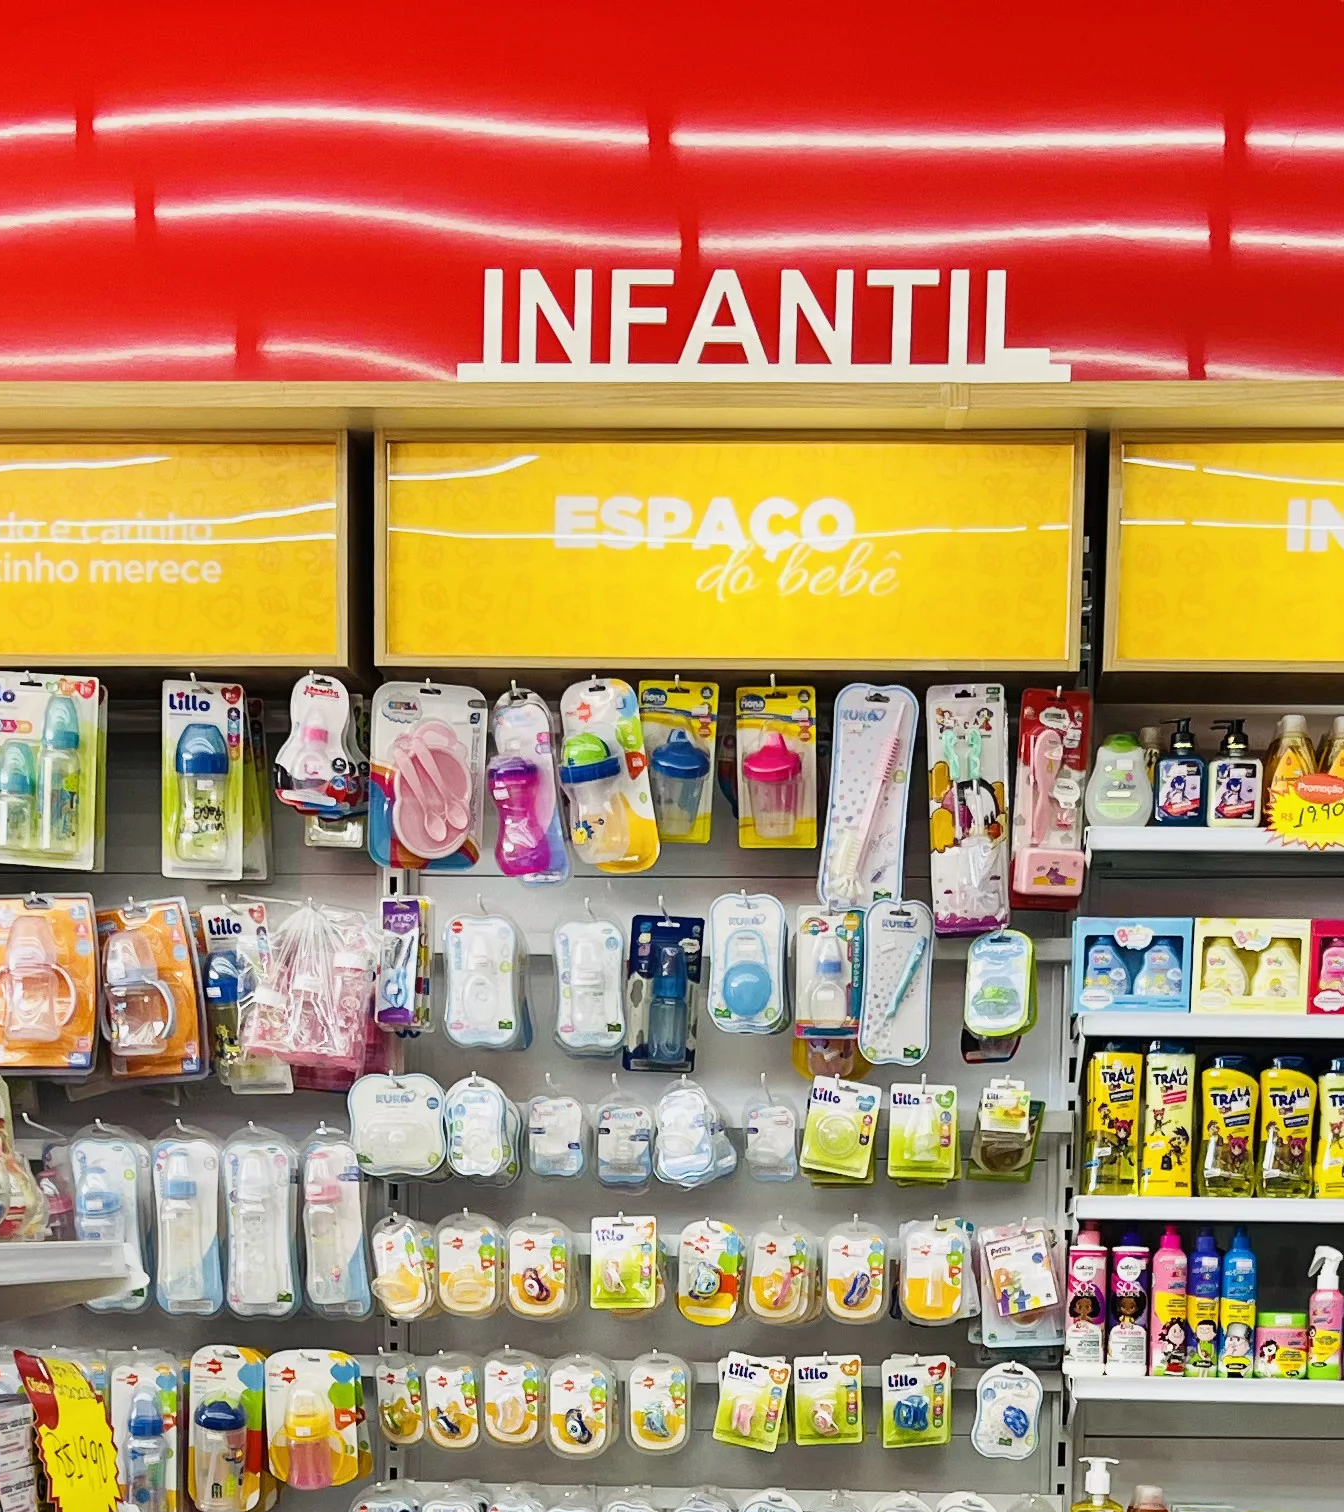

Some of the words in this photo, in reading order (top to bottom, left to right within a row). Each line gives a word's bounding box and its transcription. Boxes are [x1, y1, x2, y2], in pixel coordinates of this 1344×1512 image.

[484, 269, 1050, 364] INFANTIL
[50, 520, 71, 544] e
[81, 512, 212, 543] carinho
[553, 496, 855, 561] ESPAÇO
[90, 559, 222, 584] merece
[697, 543, 756, 603] do
[777, 543, 902, 597] bebê
[168, 692, 210, 712] Lillo
[1297, 782, 1344, 796] Promoção
[207, 917, 242, 937] Lillo
[1072, 1281, 1095, 1293] SOS
[1116, 1281, 1140, 1293] SOS
[798, 1368, 828, 1381] Lillo
[887, 1374, 917, 1388] Lillo
